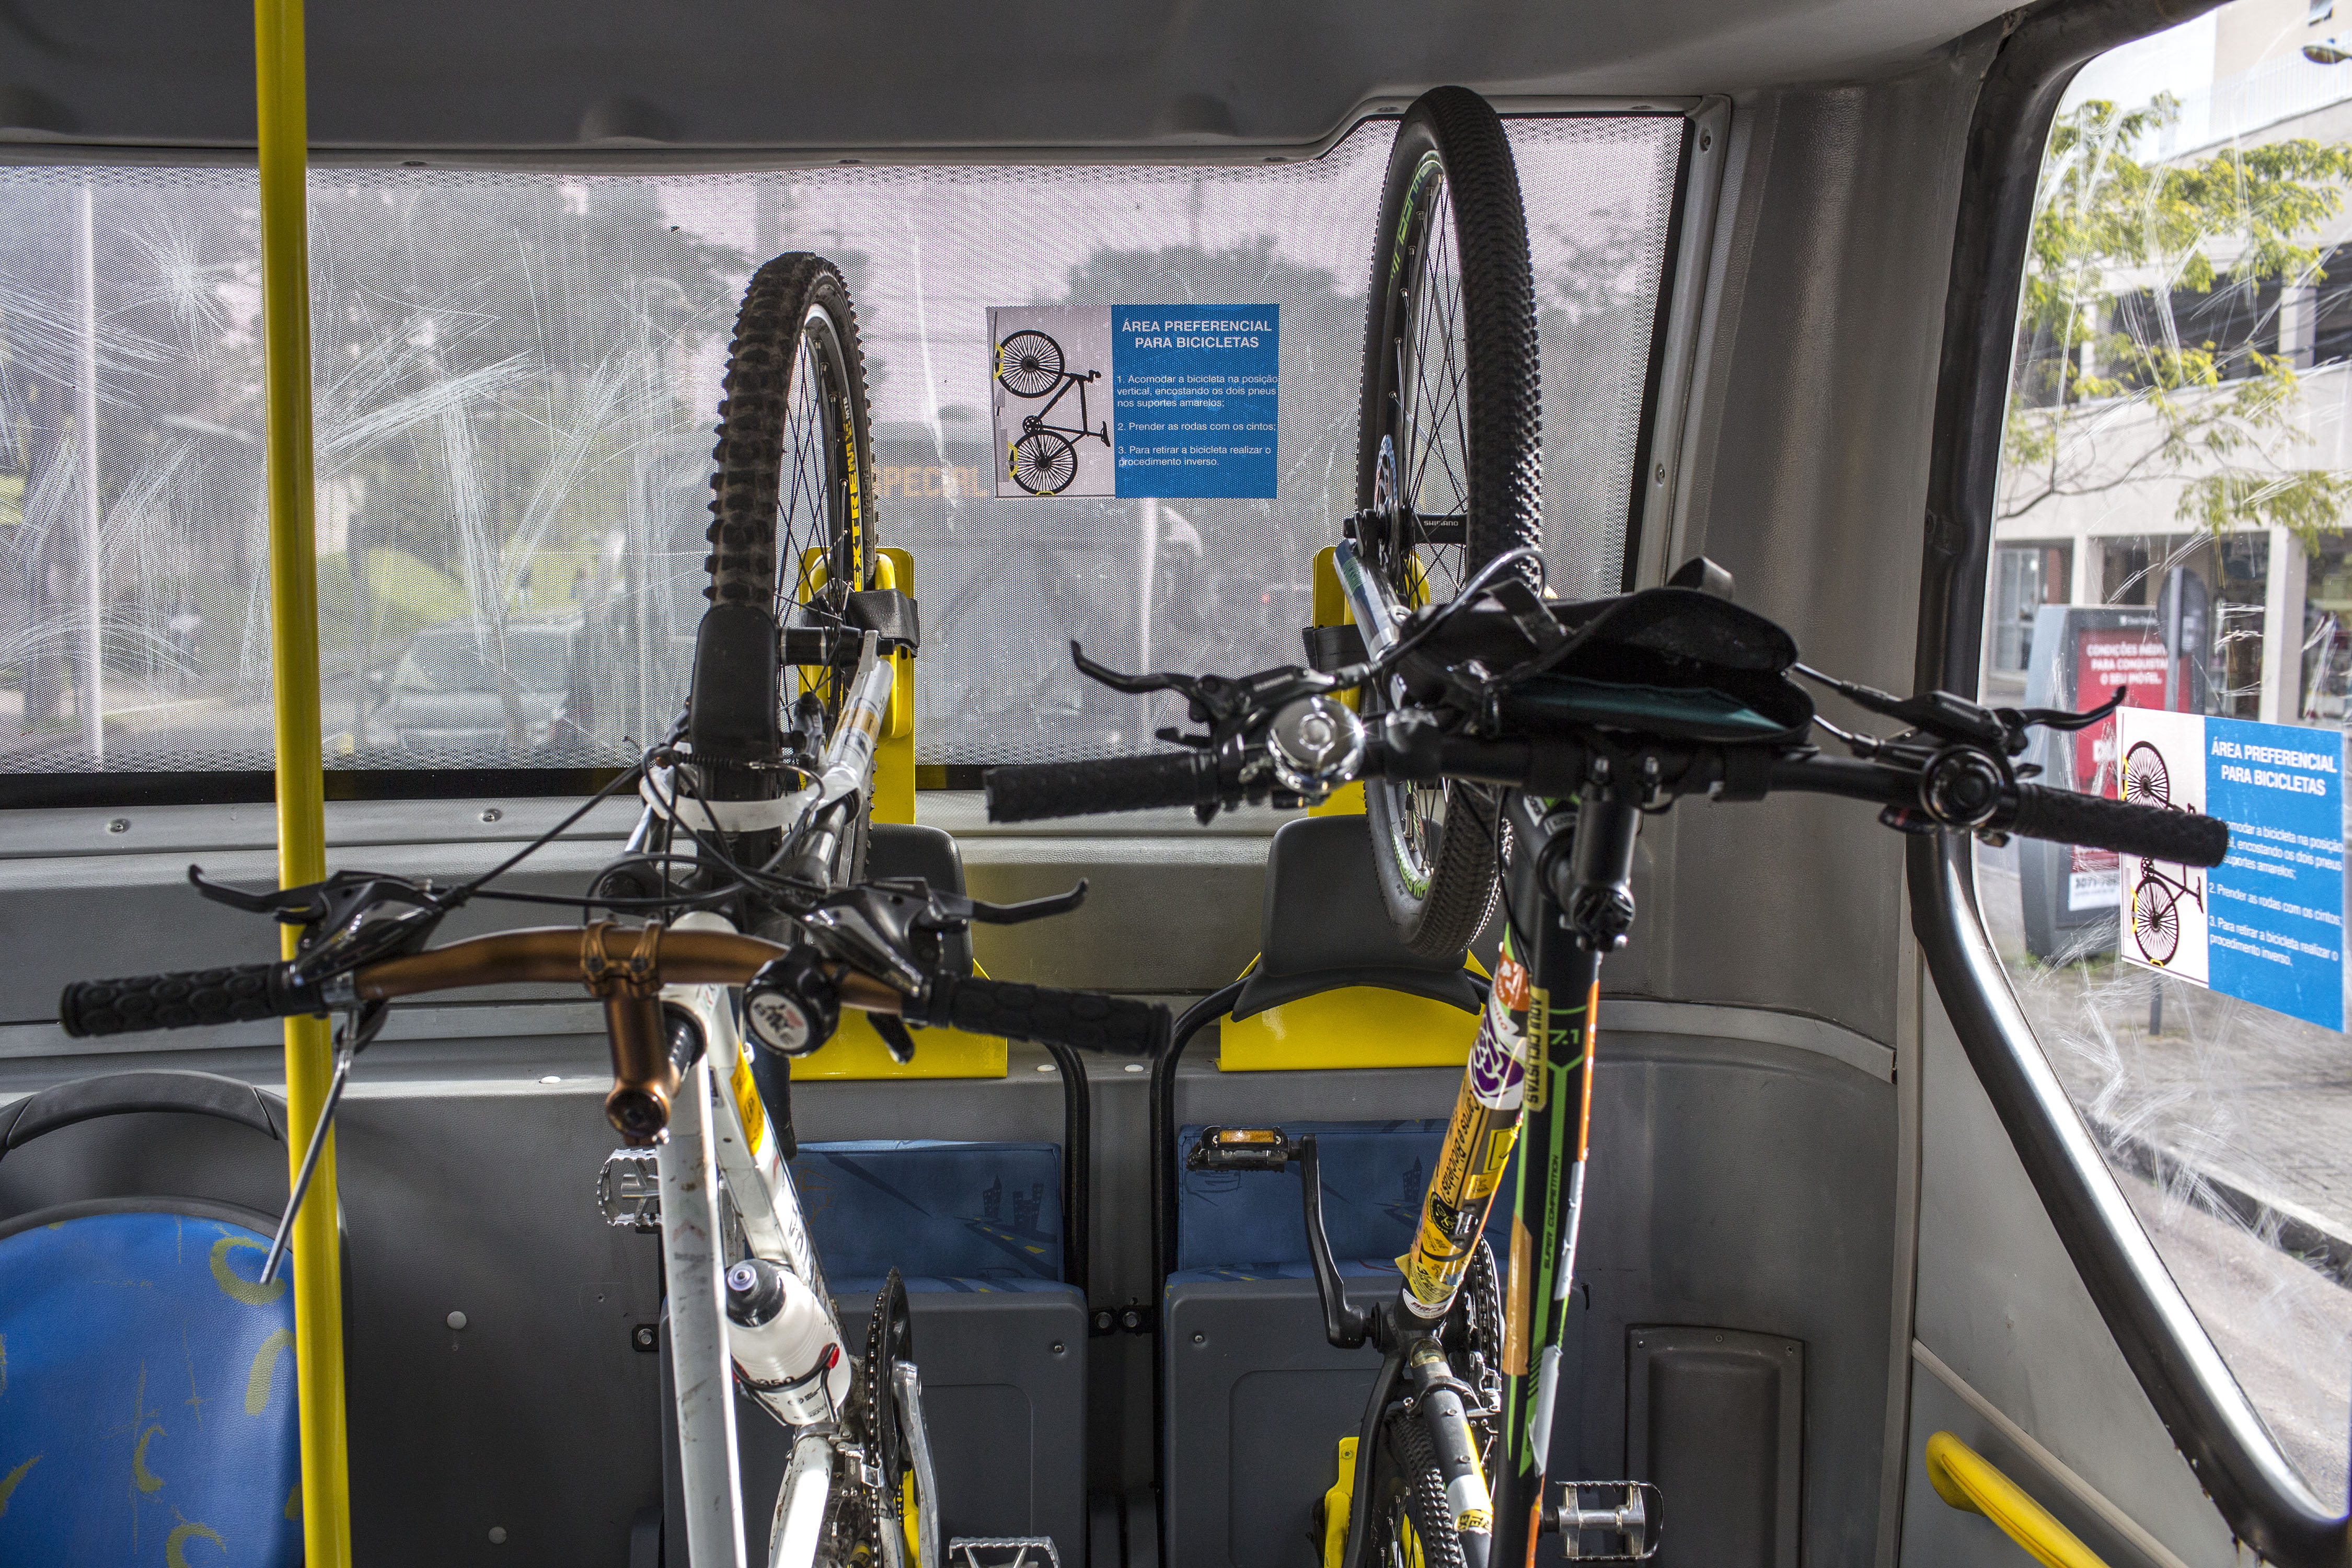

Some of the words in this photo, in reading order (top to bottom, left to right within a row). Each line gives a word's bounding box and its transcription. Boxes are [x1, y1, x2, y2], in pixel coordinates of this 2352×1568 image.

[1122, 318, 1160, 332] ÁREA
[1165, 320, 1272, 332] PREFERENCIAL
[1135, 337, 1173, 348] PARA
[1177, 337, 1259, 348] BICICLETAS
[1117, 387, 1152, 397] vertical,
[1155, 387, 1209, 395] encostando
[1226, 387, 1246, 395] dois
[1248, 388, 1276, 397] pneus
[1128, 375, 1175, 383] Acomodar
[1187, 374, 1225, 383] bicicleta
[1242, 374, 1278, 386] posição
[1137, 399, 1177, 409] suportes
[1180, 399, 1225, 408] amarelos;
[1129, 422, 1165, 431] Prender
[1181, 422, 1207, 431] rodas
[1246, 422, 1277, 431] cintos;
[1119, 458, 1181, 467] procedimento
[1152, 445, 1180, 454] retirar
[1190, 445, 1227, 454] bicicleta
[1230, 445, 1262, 454] realizar
[2211, 736, 2243, 759] ÁREA
[2244, 744, 2338, 773] PREFERENCIAL
[2221, 765, 2253, 784] PARA
[2254, 769, 2326, 796] BICICLETAS
[2224, 821, 2256, 835] omodar
[2256, 827, 2262, 836] a
[2263, 826, 2297, 844] bicicleta
[2297, 835, 2309, 846] na
[2309, 837, 2344, 854] posição
[2223, 855, 2256, 870] suportes
[2257, 861, 2297, 880] amarelos;
[2237, 840, 2283, 858] encostando
[2284, 850, 2295, 861] os
[2296, 851, 2314, 865] dois
[2315, 857, 2343, 871] pneus
[2208, 882, 2216, 893] 2.
[2217, 883, 2247, 901] Prender
[2247, 893, 2258, 904] as
[2258, 897, 2282, 910] rodas
[2282, 902, 2301, 915] com
[2302, 907, 2313, 919] os
[2314, 909, 2344, 928] cintos;
[2208, 916, 2217, 927] 3.
[2217, 917, 2235, 932] Para
[2236, 924, 2258, 939] retirar
[2259, 931, 2266, 941] a
[2266, 930, 2300, 950] bicicleta
[2300, 941, 2330, 959] realizar
[2331, 951, 2339, 962] o
[2209, 933, 2261, 957] procedimento
[2261, 947, 2293, 966] inverso.
[1529, 998, 1541, 1030] AQUI
[1548, 1029, 1579, 1045] 7.1
[1526, 1033, 1541, 1104] CICLISTAS
[1460, 1089, 1480, 1135] Carros
[1457, 1128, 1466, 1144] e
[1440, 1137, 1467, 1205] Bicicletas?
